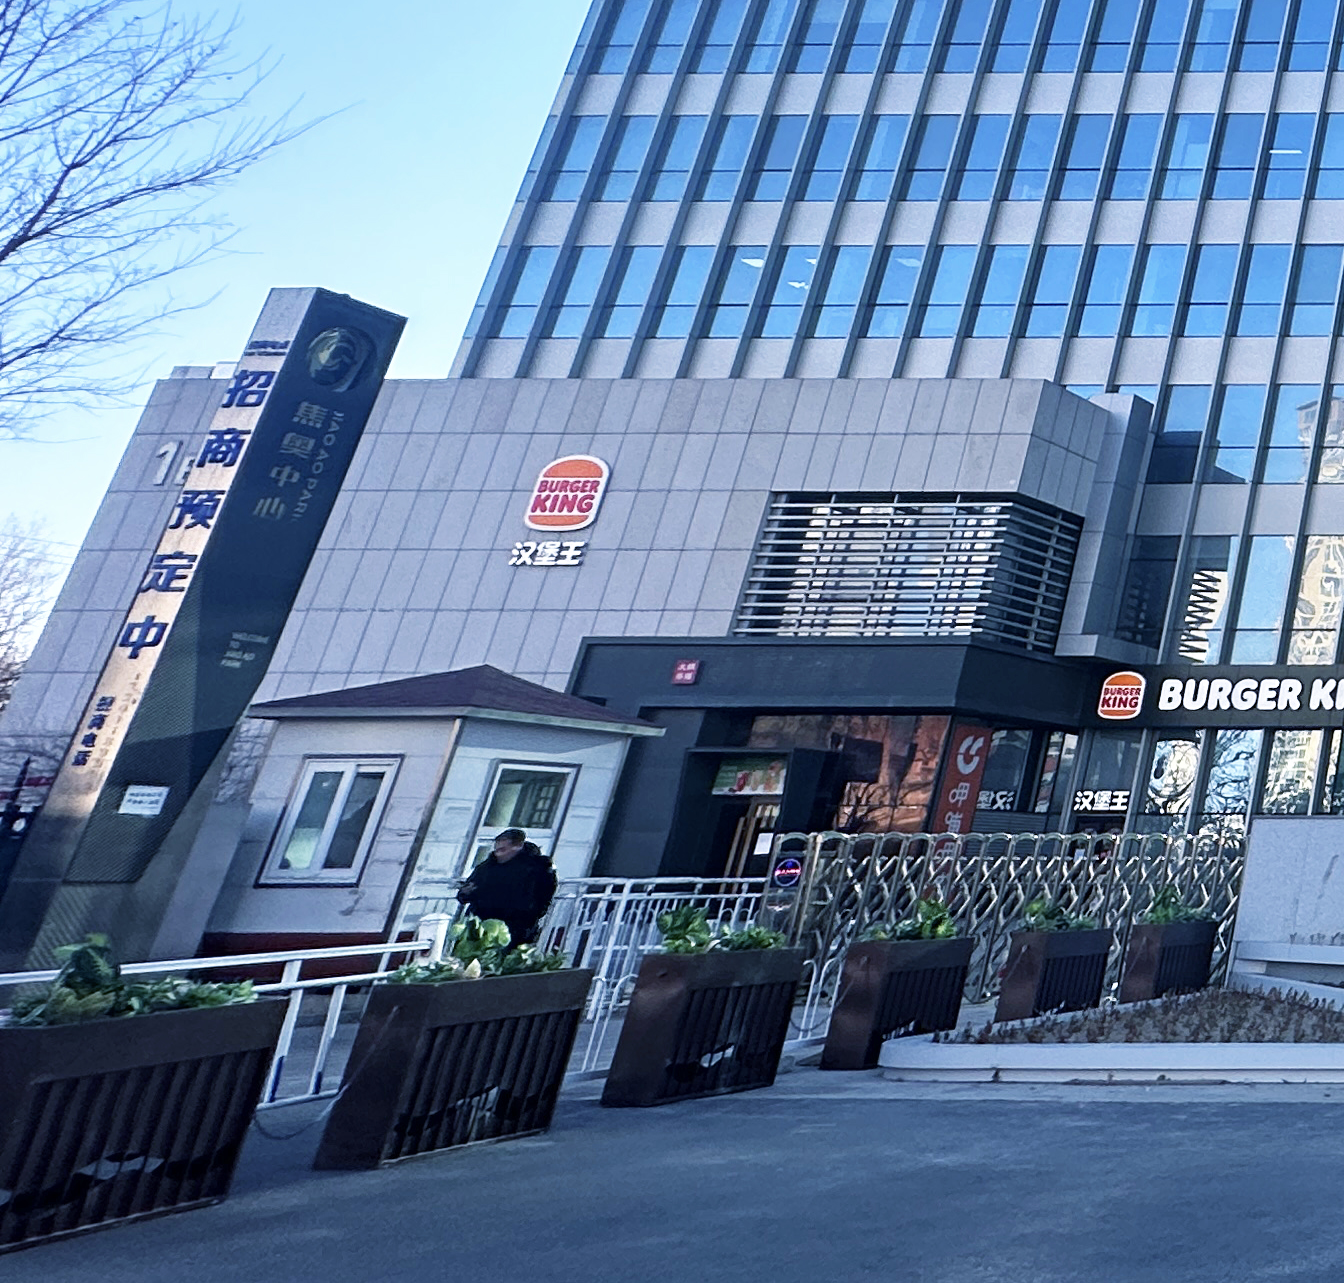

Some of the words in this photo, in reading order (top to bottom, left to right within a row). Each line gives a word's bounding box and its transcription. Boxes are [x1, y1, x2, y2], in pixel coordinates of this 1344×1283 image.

[322, 409, 345, 447] JIAO
[252, 400, 329, 521] 焦奥中心
[311, 447, 330, 475] AO
[537, 479, 601, 494] BURGER
[119, 369, 276, 660] 招商预定中
[530, 493, 596, 514] KING
[507, 540, 586, 567] 汉堡王
[1100, 696, 1140, 709] KING
[1103, 687, 1142, 697] BURGER
[1157, 677, 1303, 712] BURGER
[1073, 789, 1131, 812] 汉堡王
